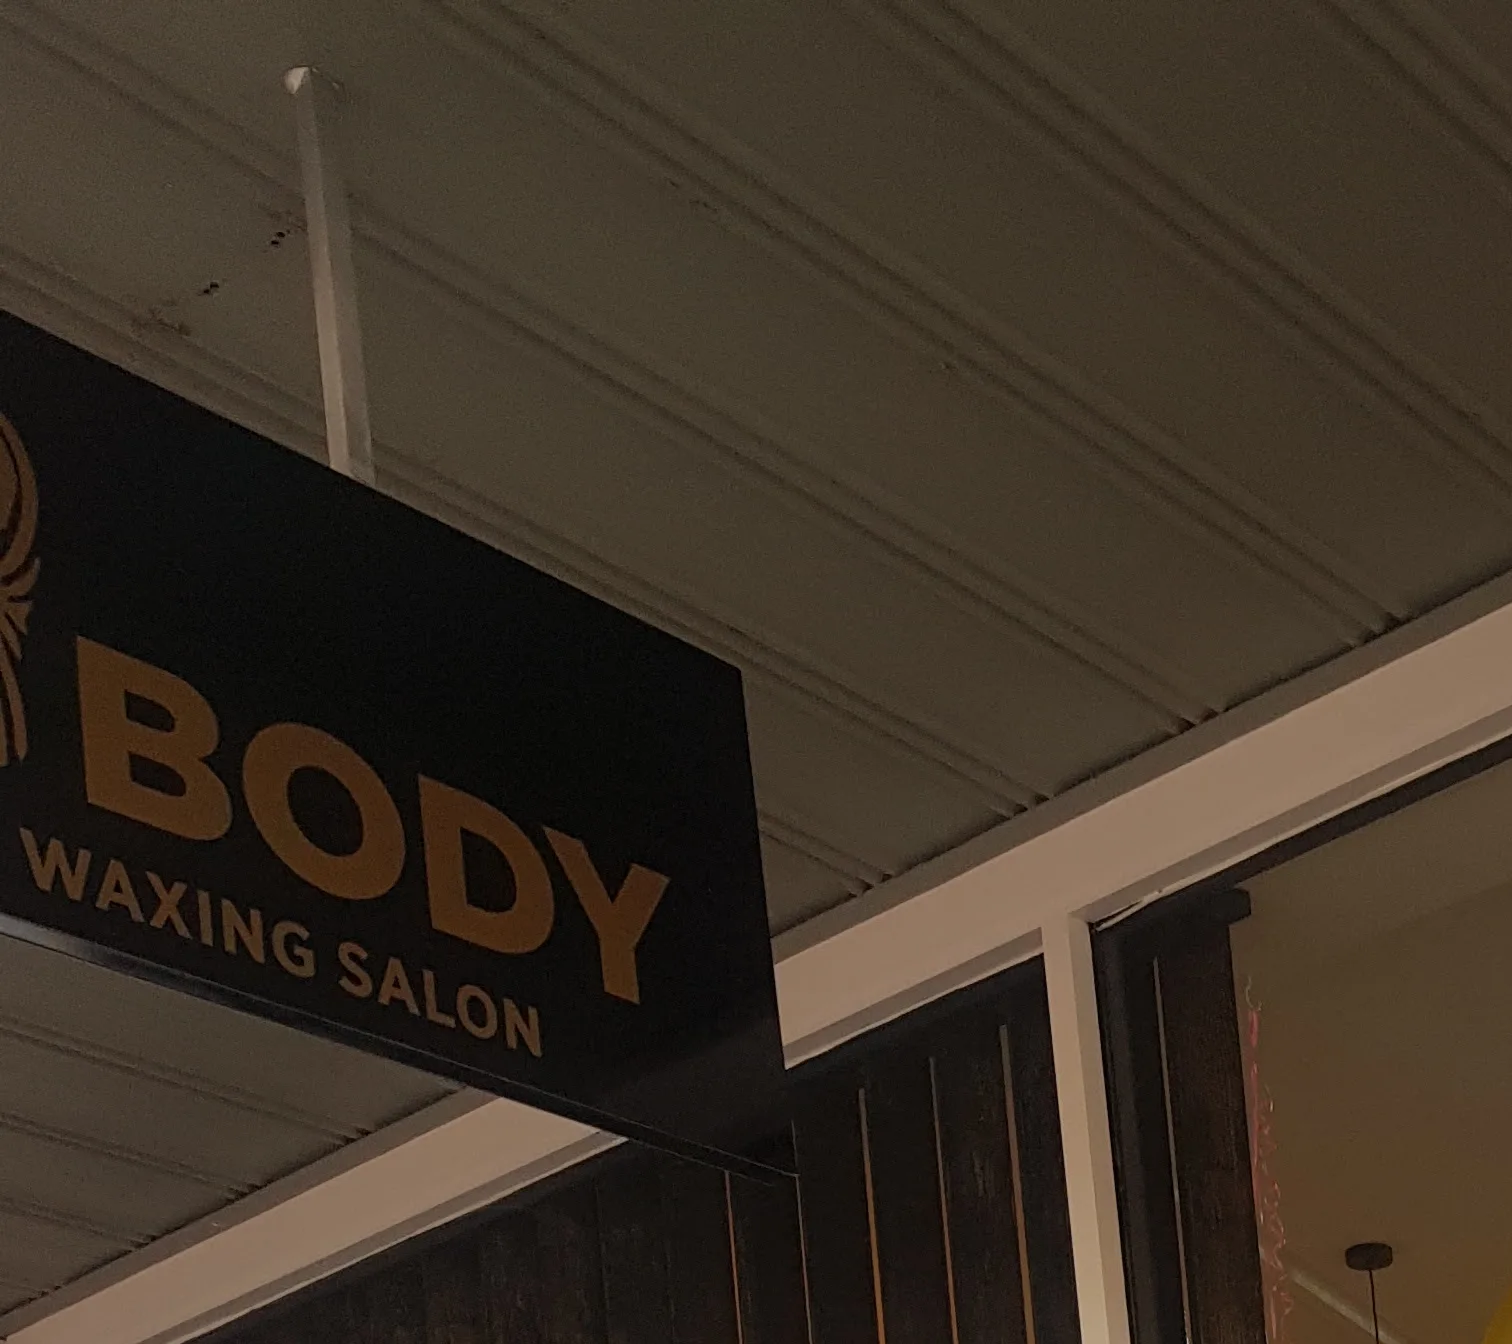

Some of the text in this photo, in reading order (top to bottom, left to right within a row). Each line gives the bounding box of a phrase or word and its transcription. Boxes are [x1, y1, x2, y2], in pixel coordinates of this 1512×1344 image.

[20, 827, 542, 1058] WAXING SALON
[77, 635, 670, 1003] BODY
